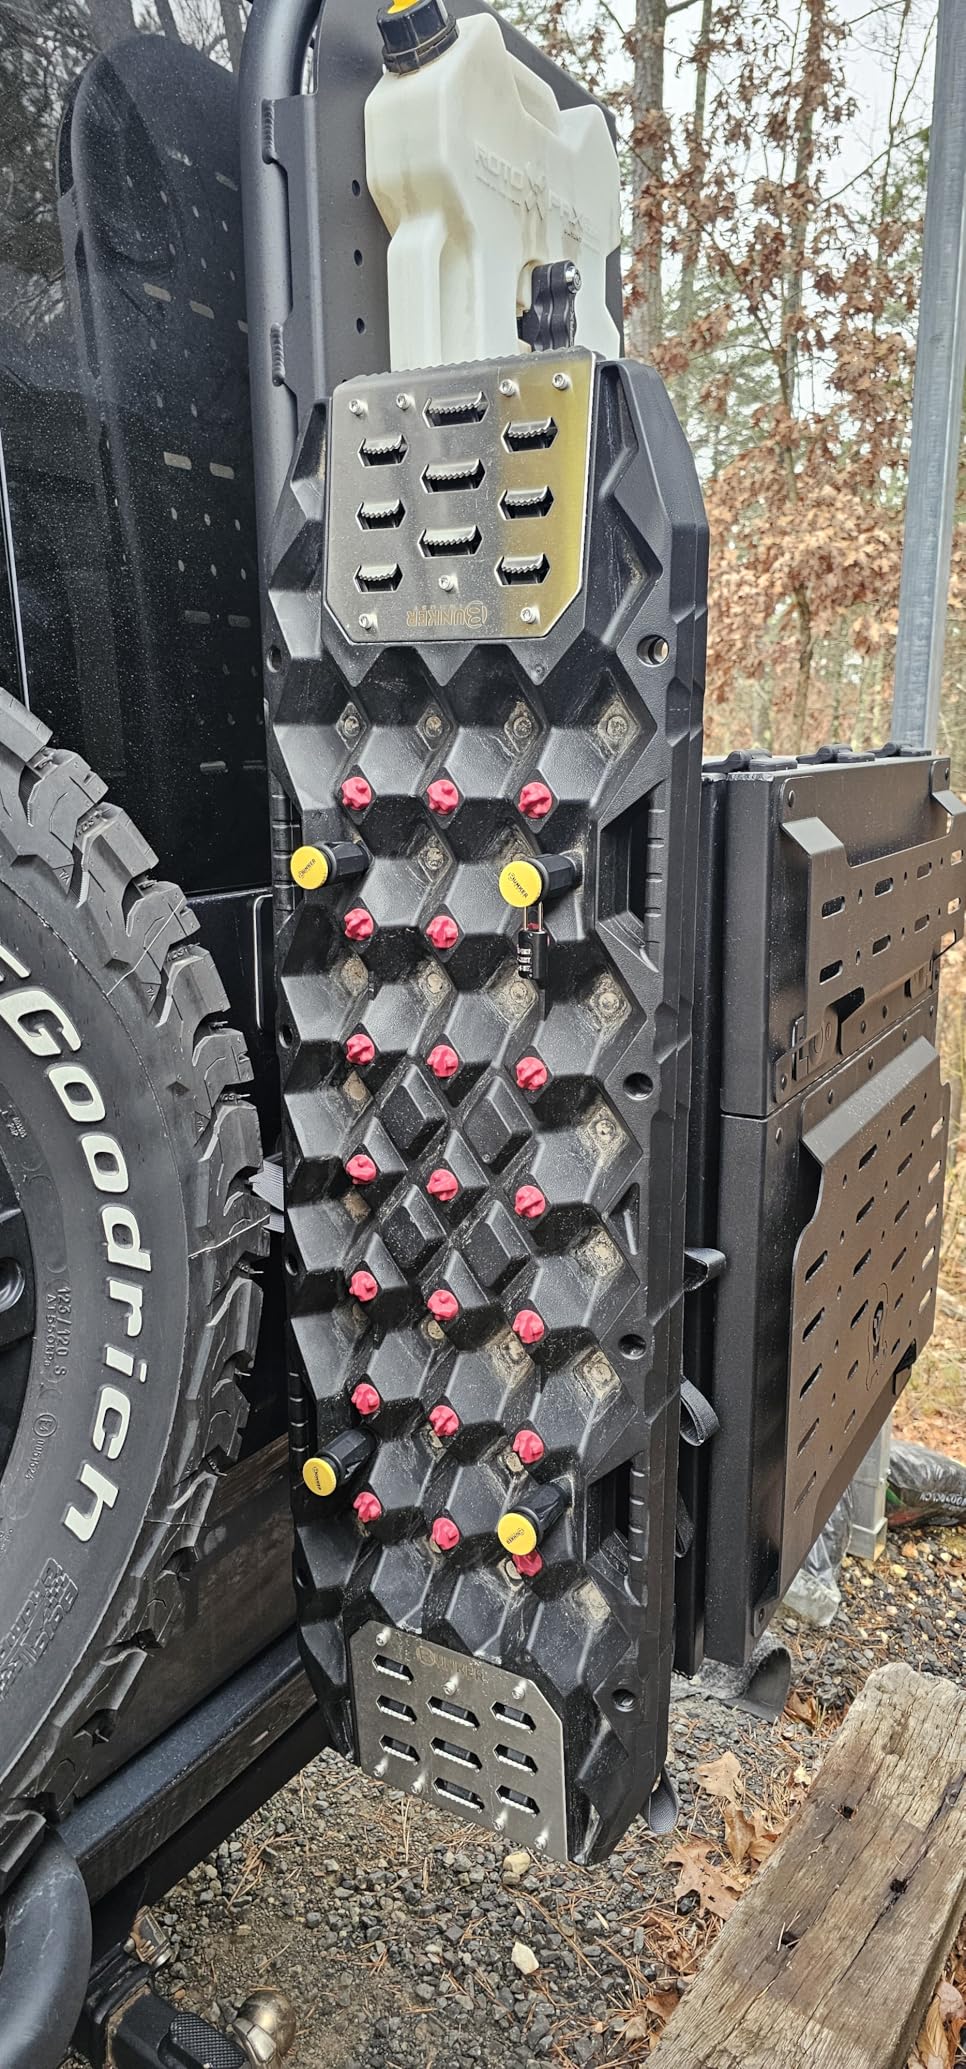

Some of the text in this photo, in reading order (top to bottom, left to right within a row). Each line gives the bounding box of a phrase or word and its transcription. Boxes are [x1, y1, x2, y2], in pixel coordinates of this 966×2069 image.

[406, 600, 488, 629] BUNKER
[507, 871, 530, 899] BUNKER
[0, 944, 152, 1542] Goodrich
